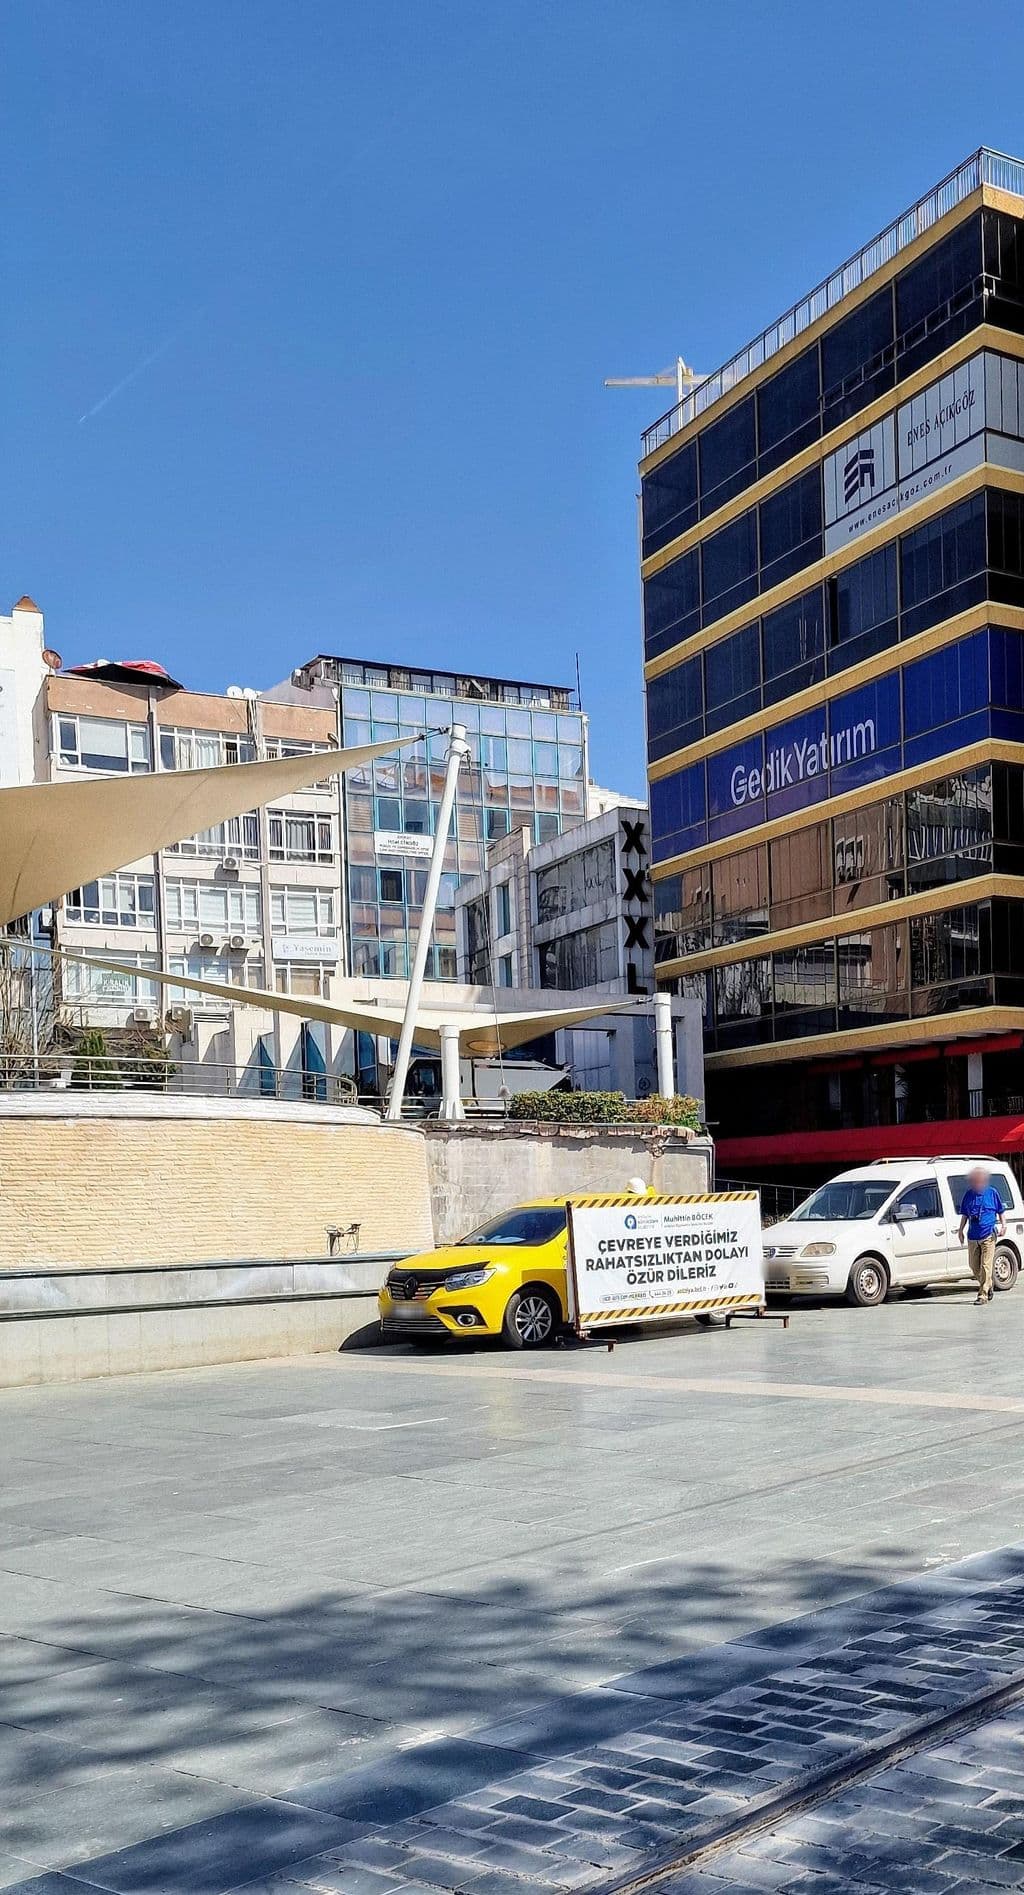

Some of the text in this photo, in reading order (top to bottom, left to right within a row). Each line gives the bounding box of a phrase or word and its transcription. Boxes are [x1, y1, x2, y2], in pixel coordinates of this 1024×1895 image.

[907, 389, 976, 446] ENES AÇIKGÖZ
[848, 464, 953, 533] www.enesackgoz.com.tr
[663, 1214, 691, 1223] Muhittin
[598, 1228, 738, 1256] ÇEVREYE VERDİĞİMİZ
[585, 1246, 749, 1271] RAHATSIZLIKTAN DOLAYI
[626, 1263, 717, 1285] ÖZÜR DİLERİZ
